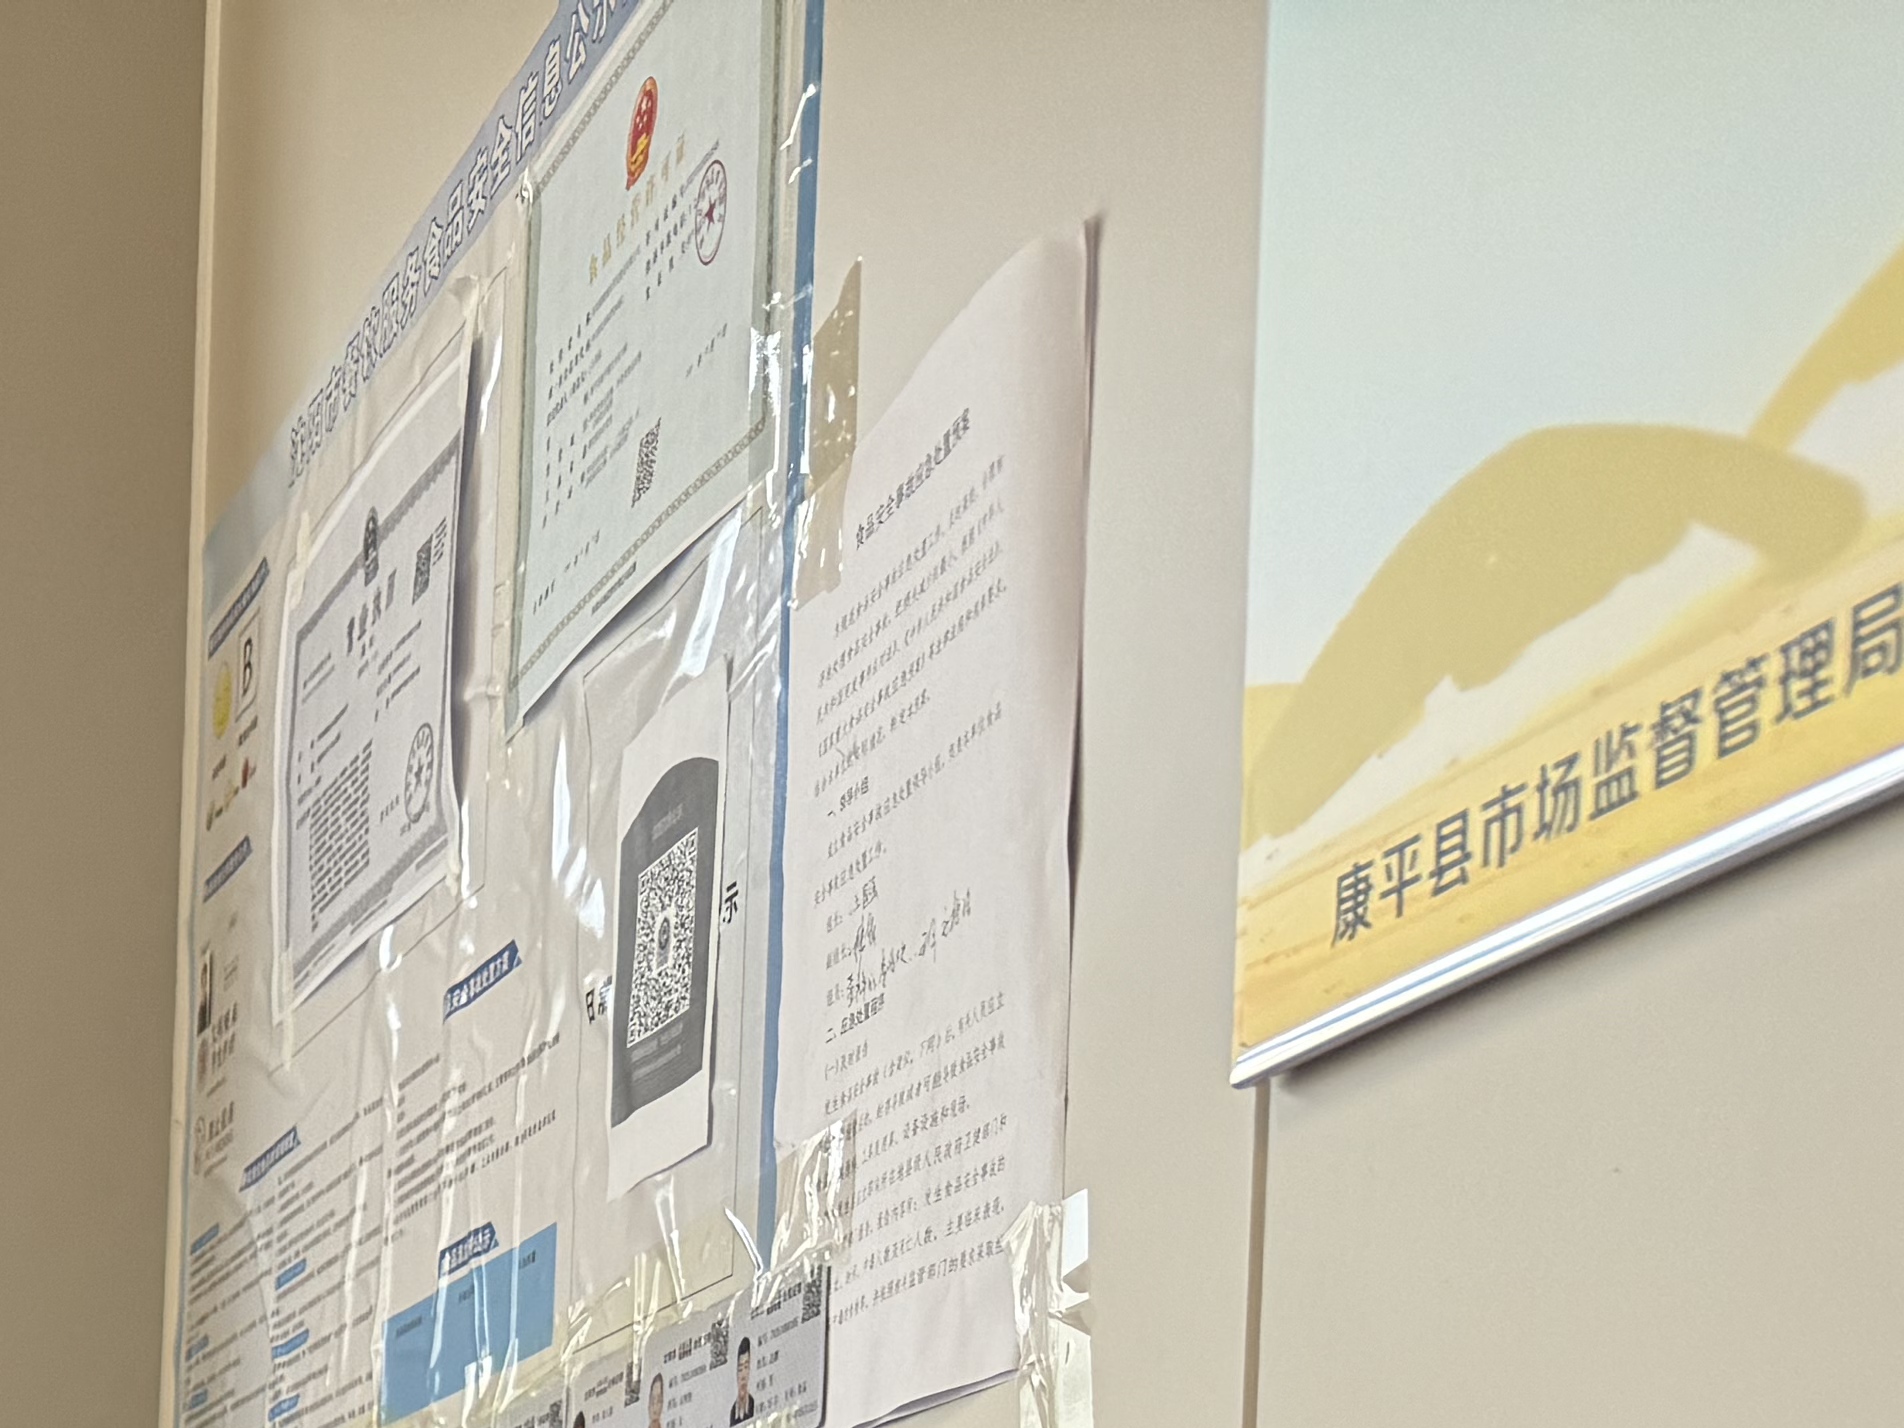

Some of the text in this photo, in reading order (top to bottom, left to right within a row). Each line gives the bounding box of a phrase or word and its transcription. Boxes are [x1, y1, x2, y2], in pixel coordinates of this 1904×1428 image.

[289, 0, 624, 487] 沈阳市餐饮服务食品安全信息公示
[855, 407, 971, 550] 食品安全事故应急处置预案
[1329, 580, 1904, 948] 康平县市场监督管理局
[722, 881, 739, 924] 示
